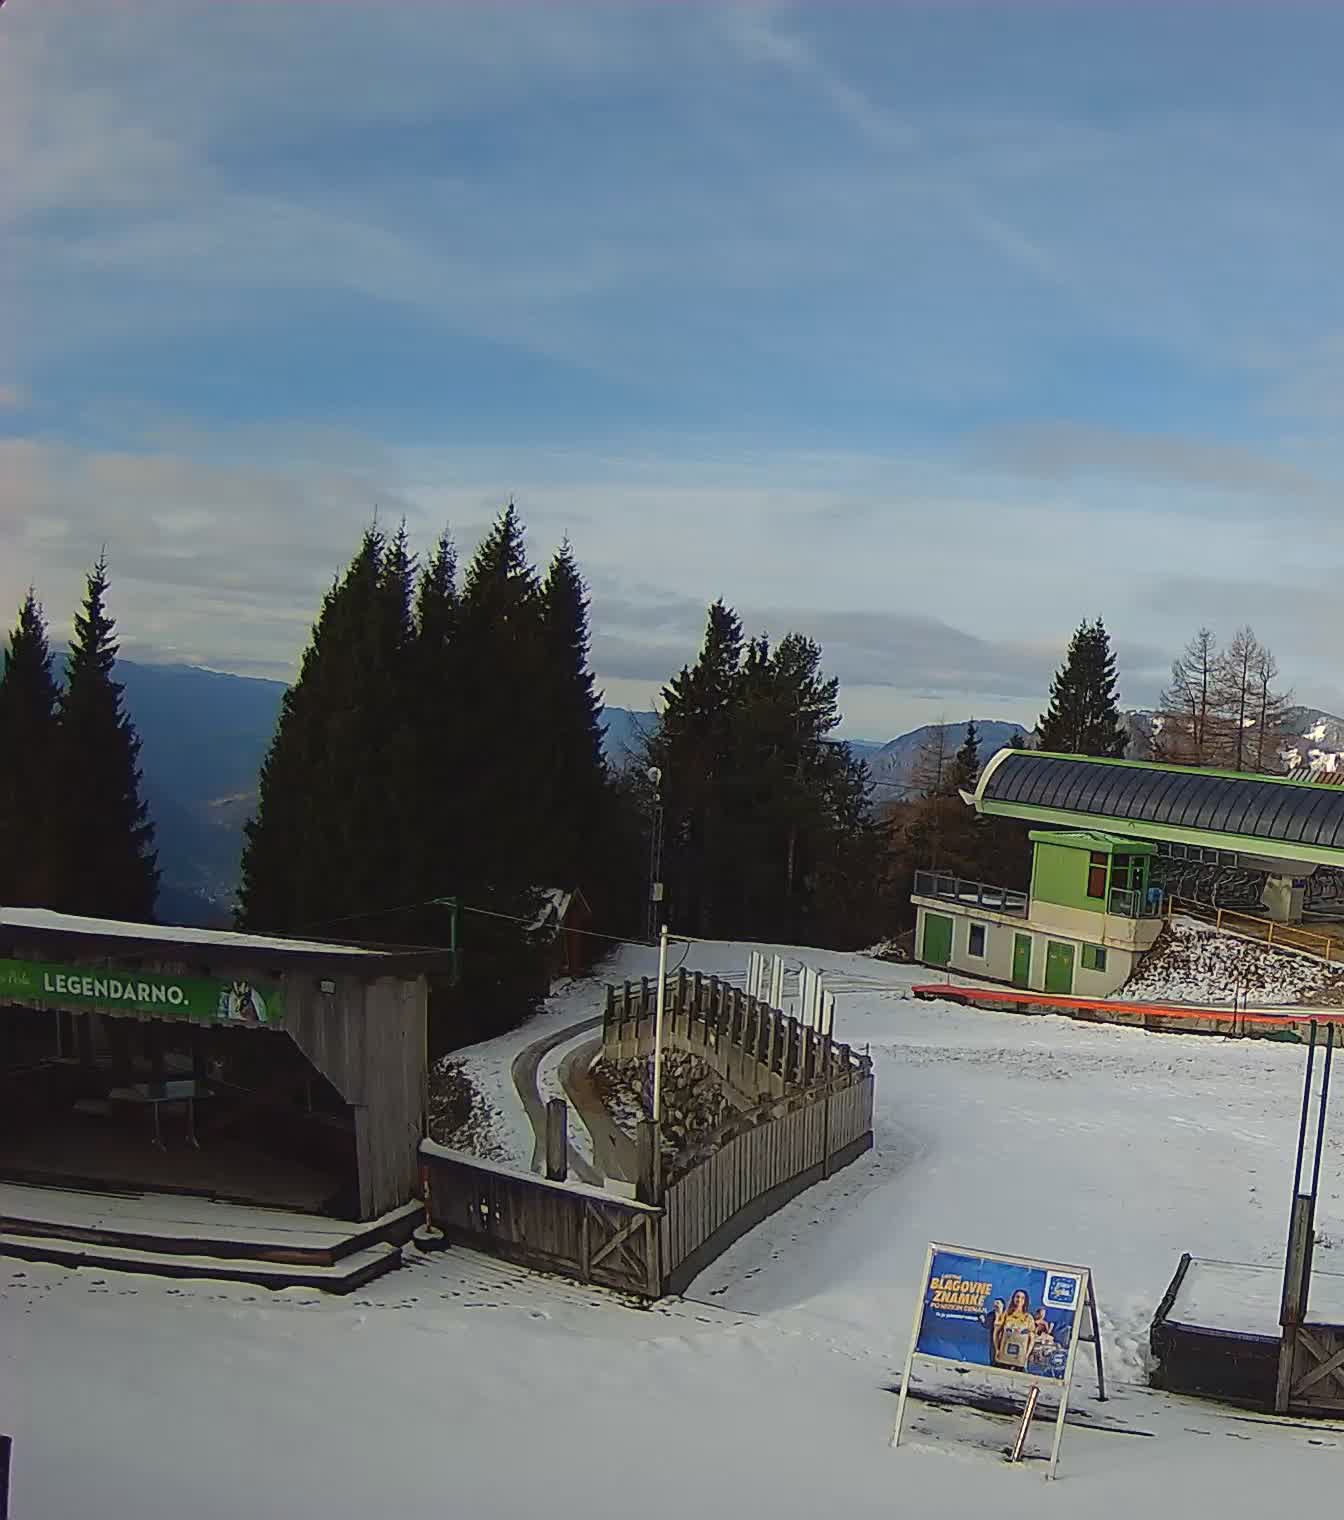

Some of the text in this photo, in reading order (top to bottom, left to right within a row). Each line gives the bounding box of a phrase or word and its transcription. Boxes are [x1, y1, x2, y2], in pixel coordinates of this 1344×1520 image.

[43, 971, 190, 1006] LEGENDARNO.
[930, 1277, 992, 1296] BLAGOVNE
[932, 1290, 986, 1306] ZNAMKE
